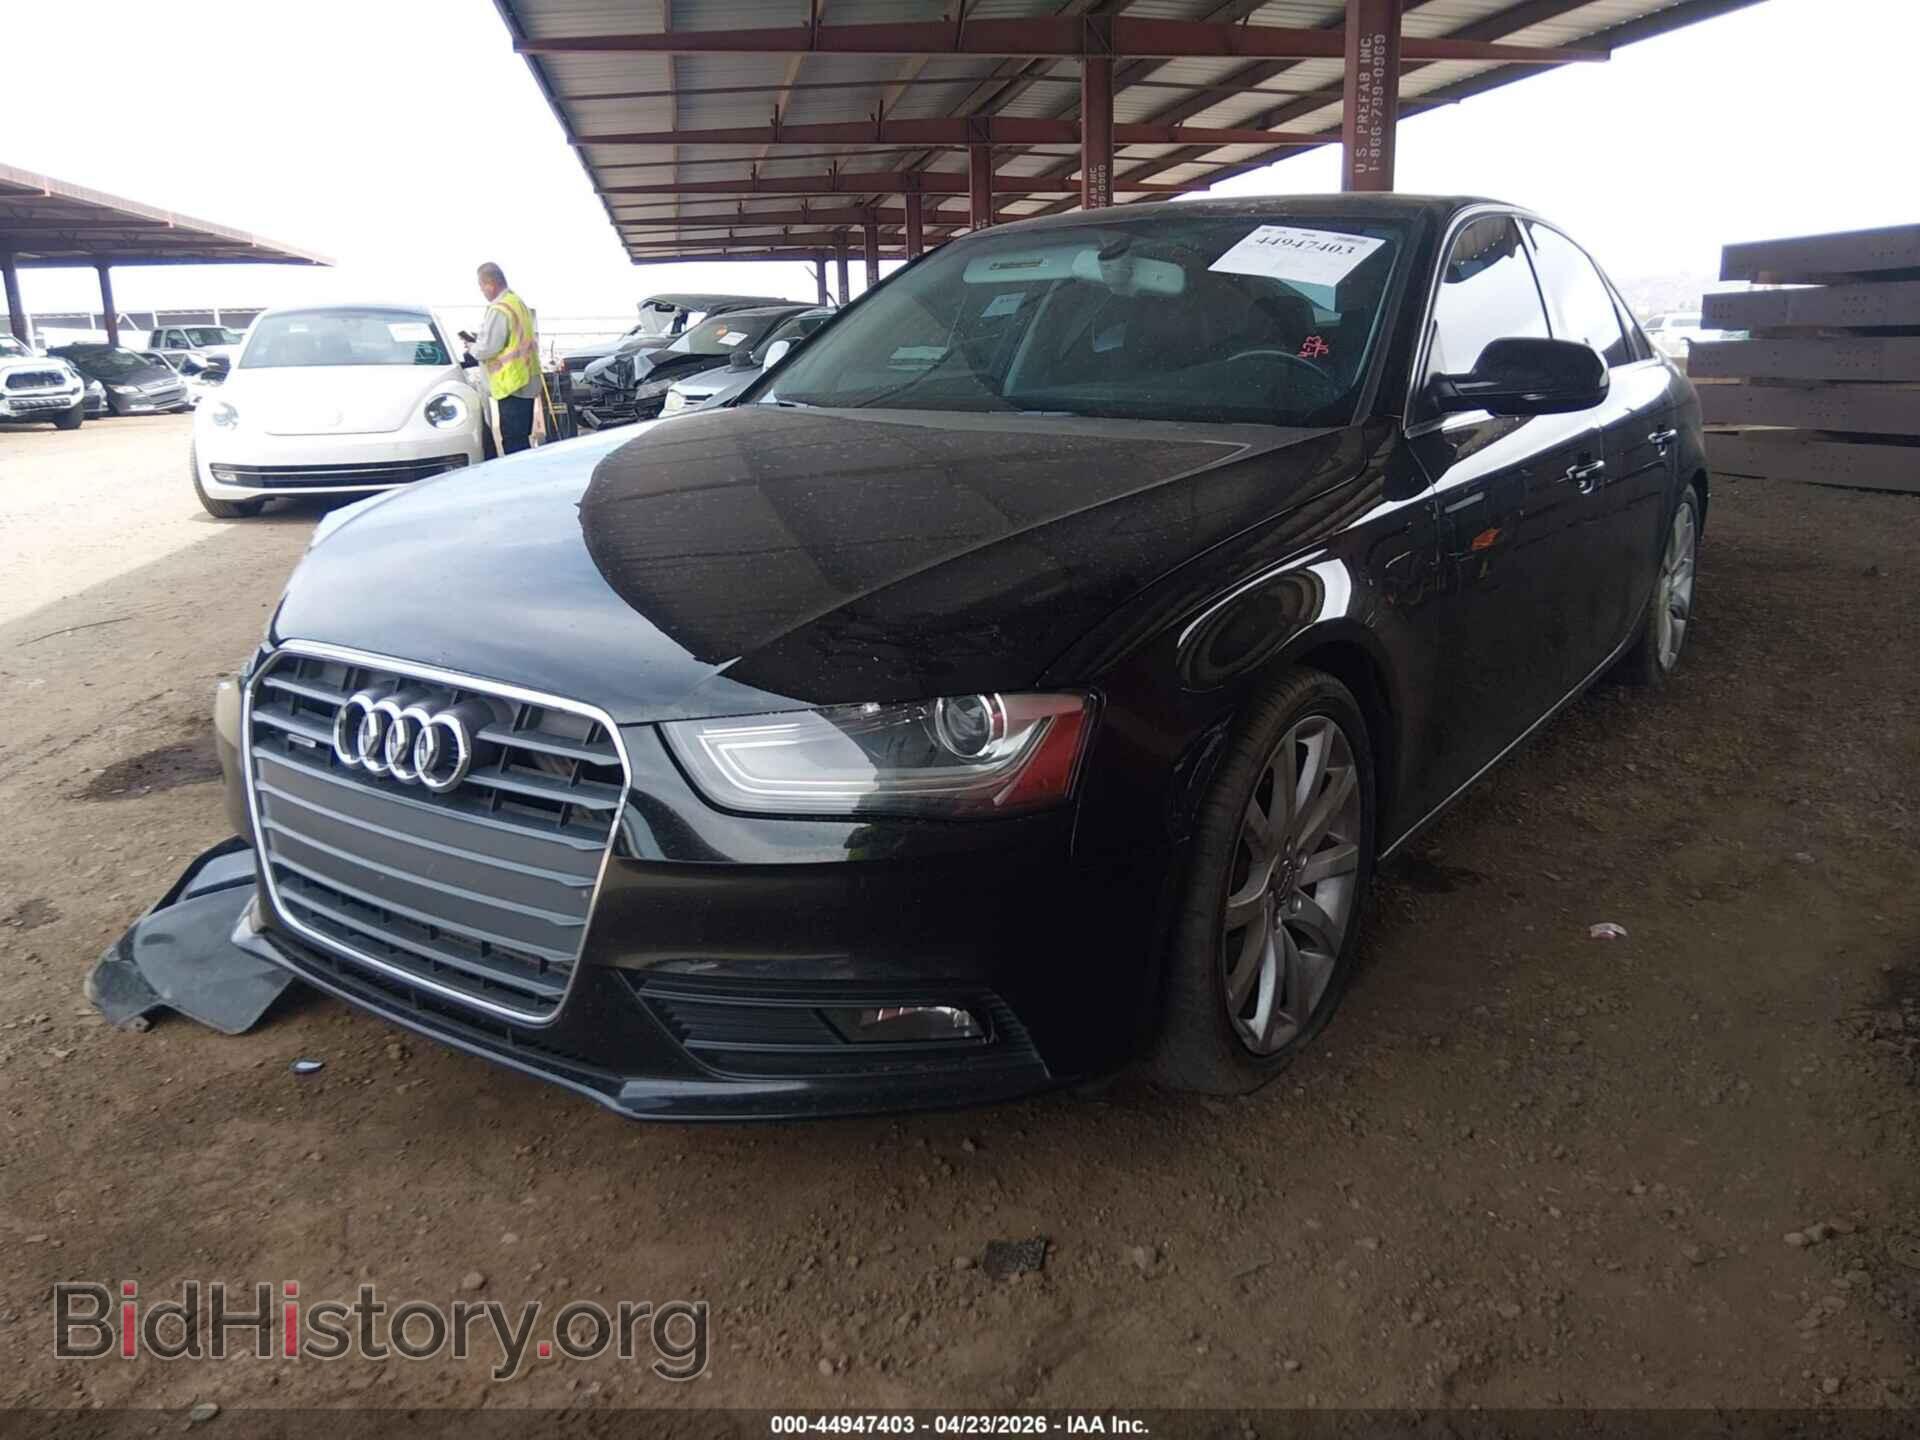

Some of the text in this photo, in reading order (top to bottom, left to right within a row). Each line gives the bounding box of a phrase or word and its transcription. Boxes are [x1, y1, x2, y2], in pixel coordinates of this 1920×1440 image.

[1360, 32, 1373, 64] INC.
[1356, 71, 1372, 134] PREFAB
[1368, 33, 1386, 173] 1-866-799-0969
[1255, 235, 1356, 256] 44947403
